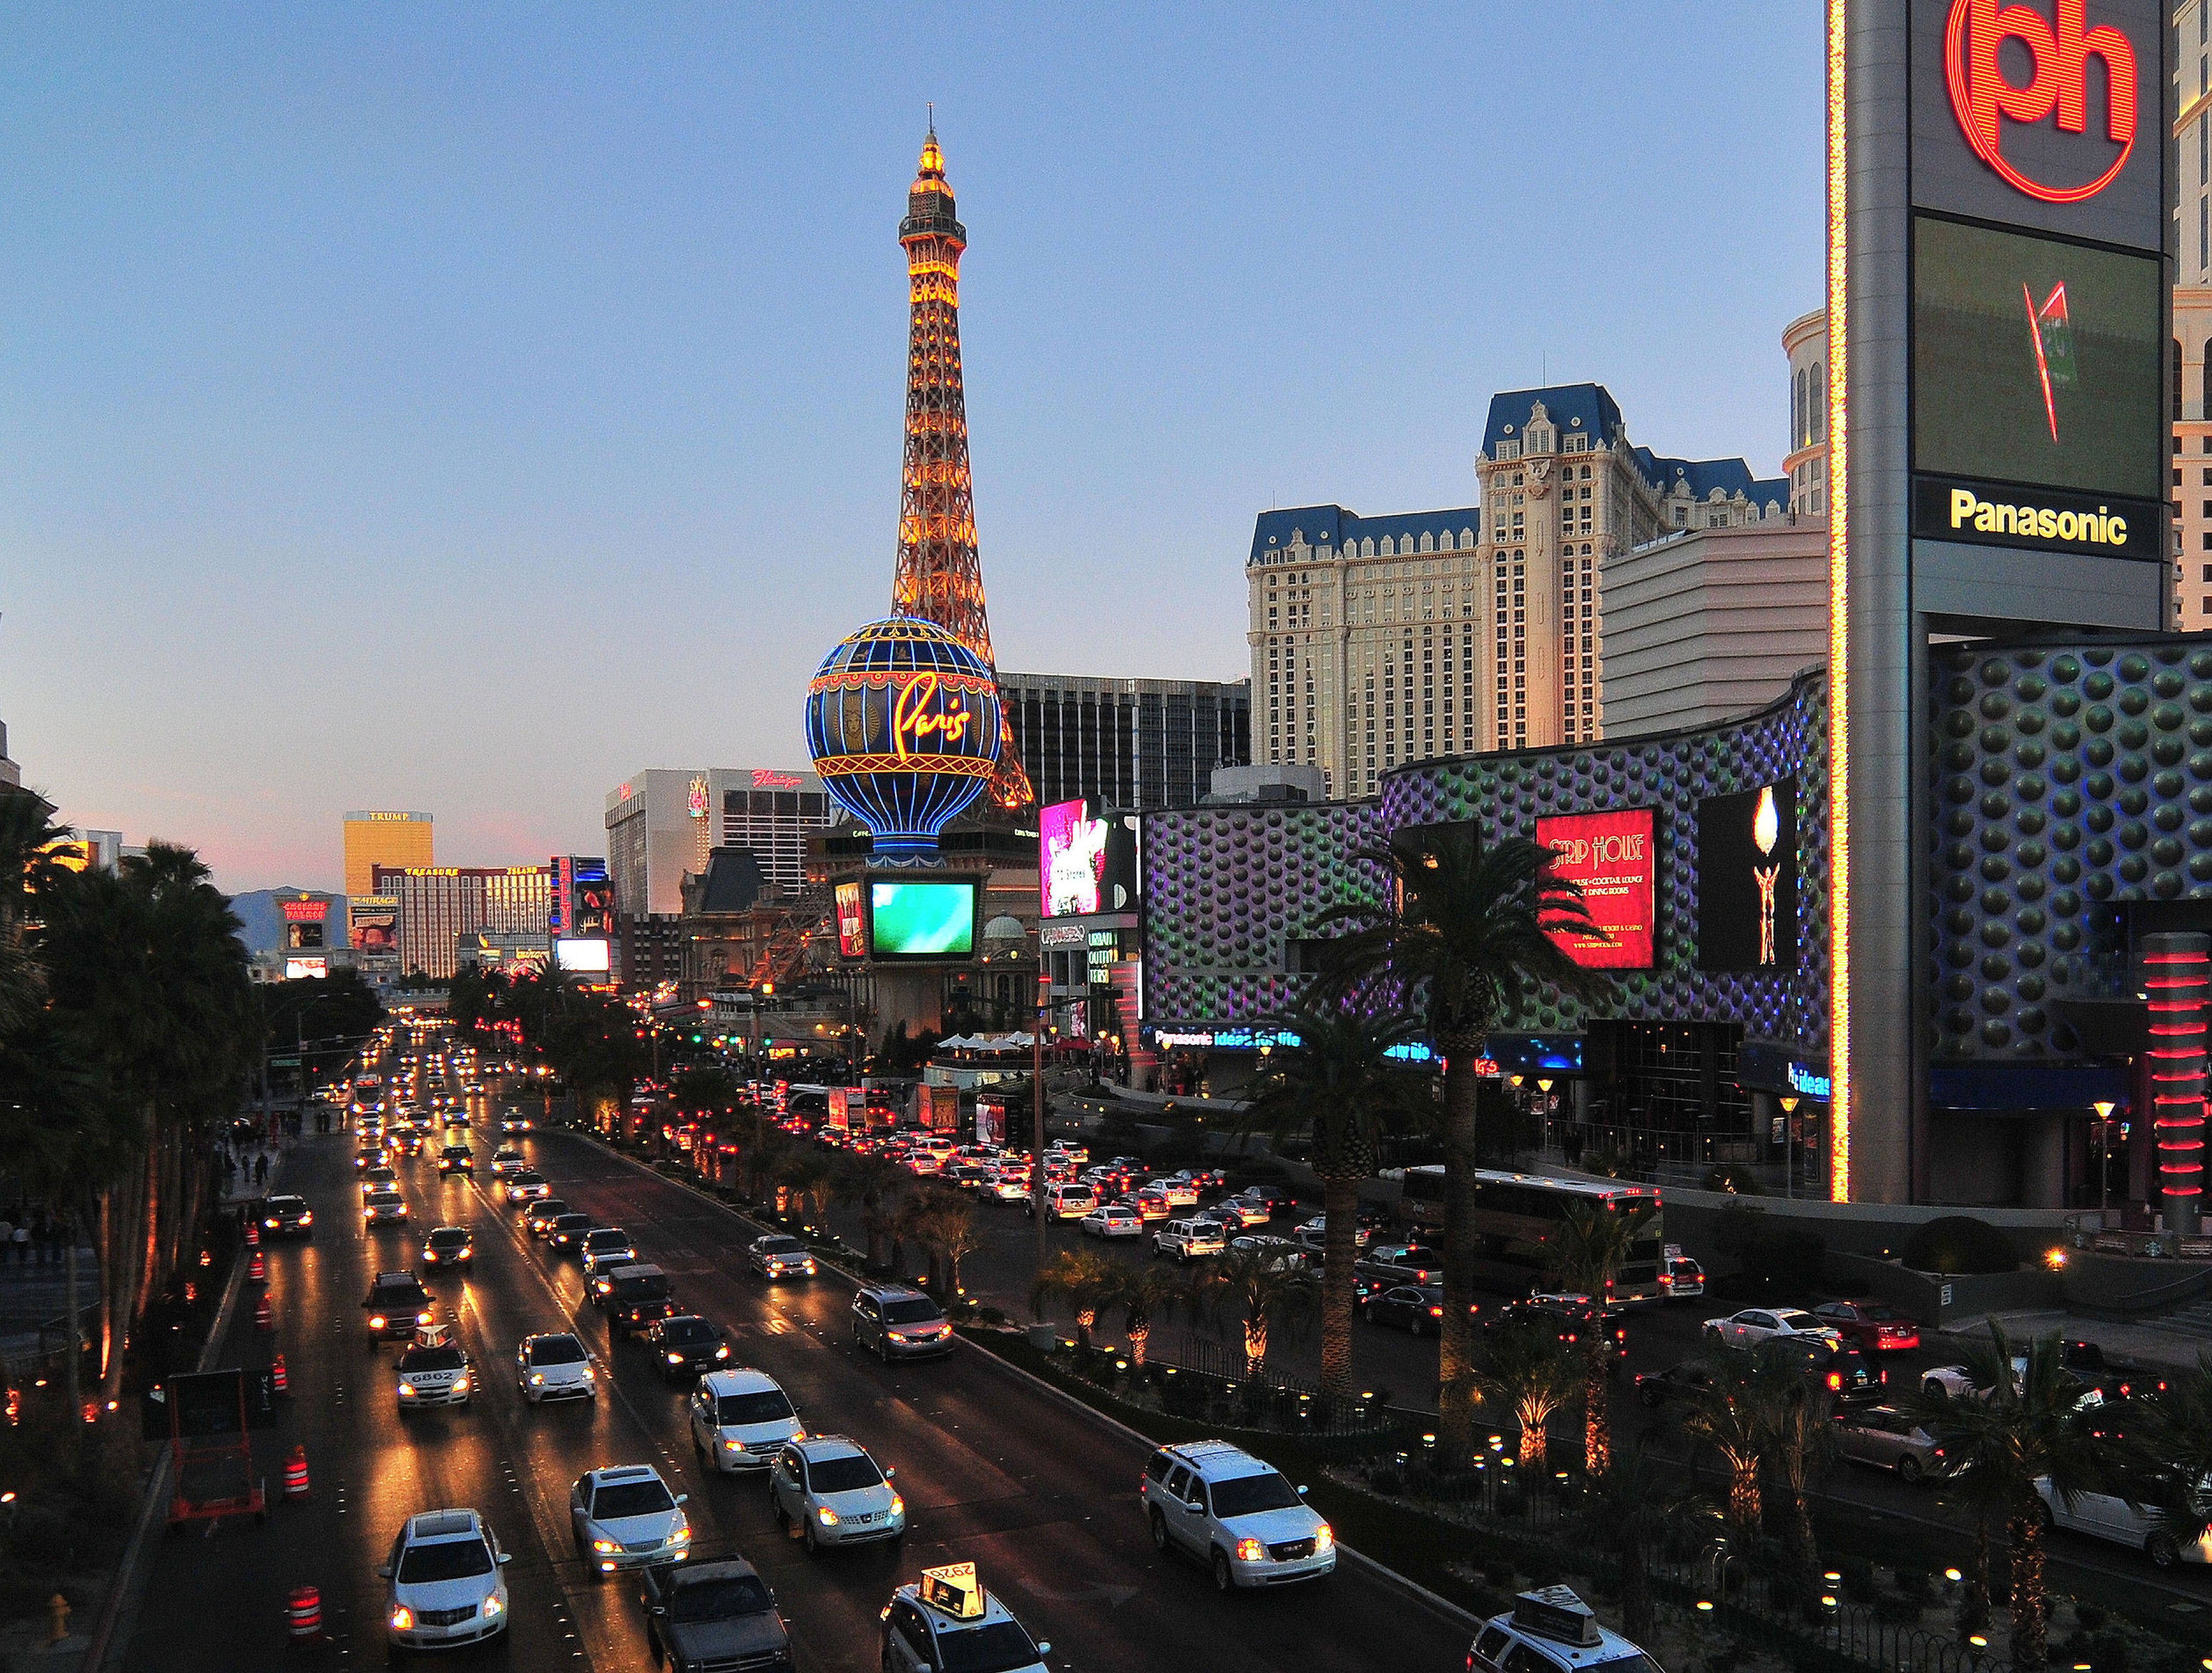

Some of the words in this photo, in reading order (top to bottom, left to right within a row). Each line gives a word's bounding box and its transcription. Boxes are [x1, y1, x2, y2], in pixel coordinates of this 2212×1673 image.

[1950, 487, 2128, 546] Panasonic
[894, 671, 971, 763] Paris
[751, 768, 803, 790] Flamingo
[369, 812, 409, 821] TRUMP
[1549, 839, 1589, 870] STRIP
[1592, 834, 1645, 870] HOUSE
[404, 868, 459, 876] TREASURE
[507, 866, 538, 875] ISLAND
[361, 897, 398, 905] MIRAGE
[1088, 932, 1113, 946] URBAN
[1155, 1030, 1213, 1045] Panasonic
[1214, 1032, 1252, 1046] ideas
[1255, 1032, 1276, 1046] for
[1277, 1032, 1301, 1047] life
[930, 1565, 974, 1580] 2926
